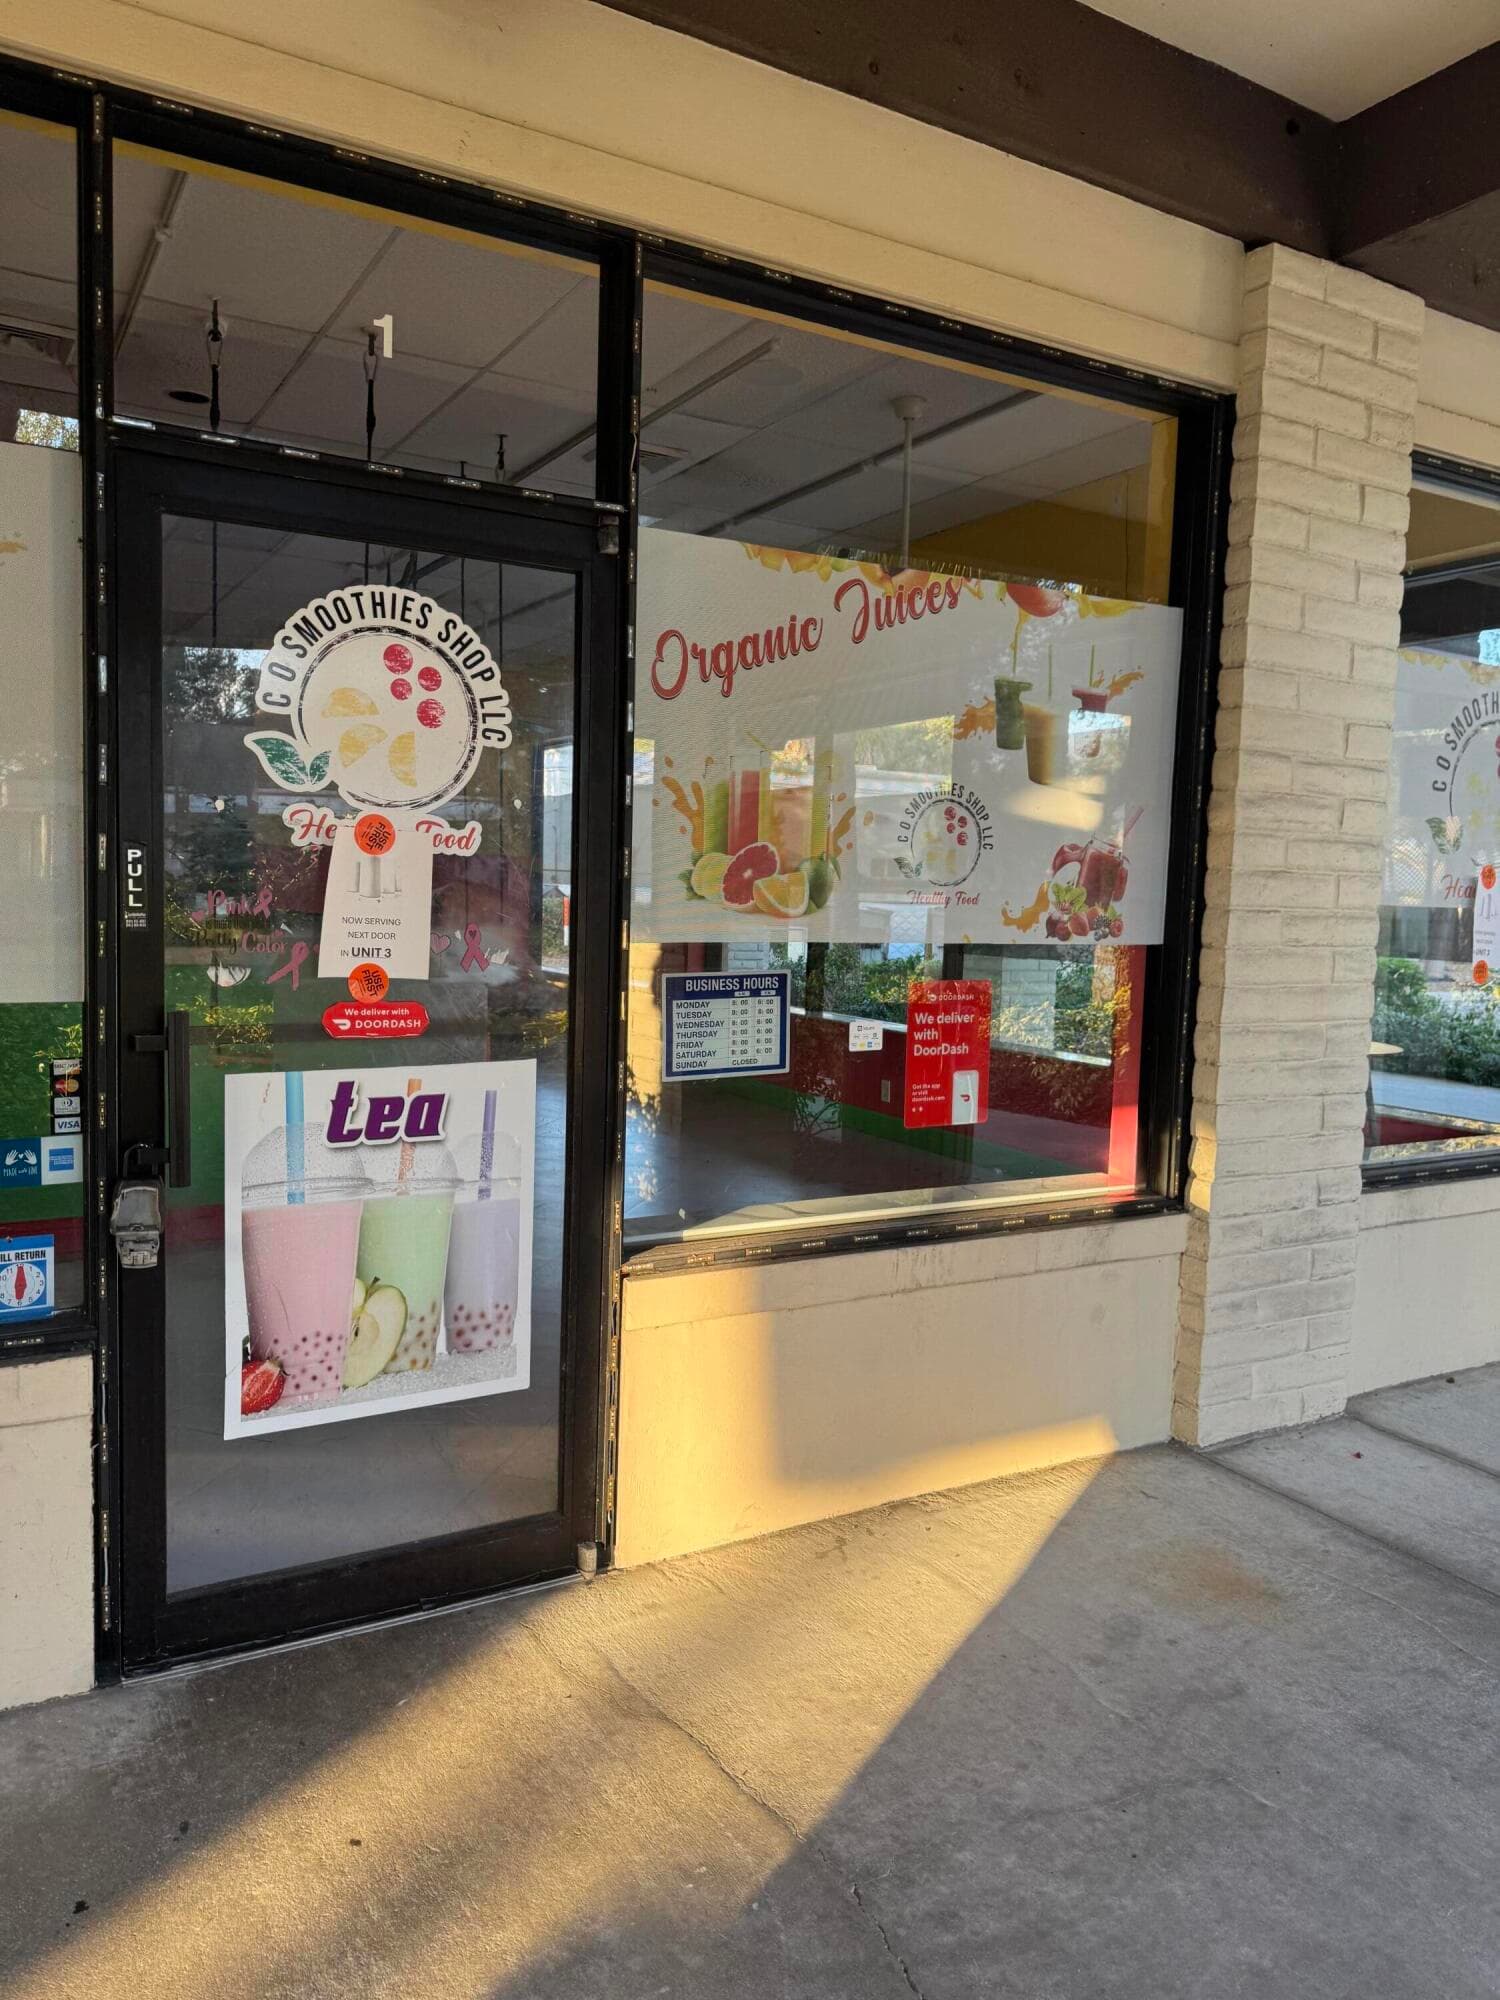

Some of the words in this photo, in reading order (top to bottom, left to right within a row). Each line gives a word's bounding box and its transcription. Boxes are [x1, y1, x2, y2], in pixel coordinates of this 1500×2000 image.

[373, 313, 393, 359] 1
[281, 591, 433, 659] SMOOTHIES
[651, 614, 823, 700] Organic
[834, 577, 965, 644] Juices
[438, 618, 495, 686] SHOP
[268, 661, 296, 682] O
[262, 691, 291, 708] C
[479, 694, 507, 743] LLC
[1436, 755, 1451, 771] O
[1432, 780, 1447, 792] C
[966, 791, 990, 822] SHOP
[982, 826, 994, 850] LLC
[366, 822, 386, 850] FIRST
[375, 831, 391, 851] USE
[127, 849, 143, 907] PULL
[954, 890, 981, 906] Food
[342, 916, 363, 925] NOW
[364, 917, 401, 926] SERVING
[241, 931, 288, 953] Color
[347, 931, 369, 939] NEXT
[371, 932, 396, 940] DOOR
[340, 949, 349, 957] IN
[351, 947, 382, 957] UNIT
[384, 948, 392, 958] 3
[362, 969, 378, 997] FIRST
[371, 970, 385, 991] USE
[685, 978, 740, 992] BUSINESS
[743, 976, 779, 990] HOURS
[344, 1008, 359, 1016] We
[360, 1008, 391, 1016] deliver
[391, 1008, 410, 1016] with
[675, 1001, 711, 1010] MONDAY
[675, 1011, 712, 1019] TUESDAY
[914, 1012, 935, 1025] We
[936, 1011, 975, 1024] deliver
[355, 1019, 421, 1029] DOORDASH
[675, 1020, 725, 1029] WEDNESDAY
[675, 1030, 718, 1039] THURSDAY
[913, 1028, 938, 1041] with
[675, 1041, 705, 1049] FRIDAY
[913, 1042, 969, 1057] DoorDash
[675, 1050, 717, 1059] SATURDAY
[675, 1060, 708, 1070] SUNDAY
[731, 1058, 758, 1066] CLOSED
[326, 1080, 446, 1144] tea
[58, 1120, 80, 1129] VISA
[15, 1249, 46, 1262] RETURN
